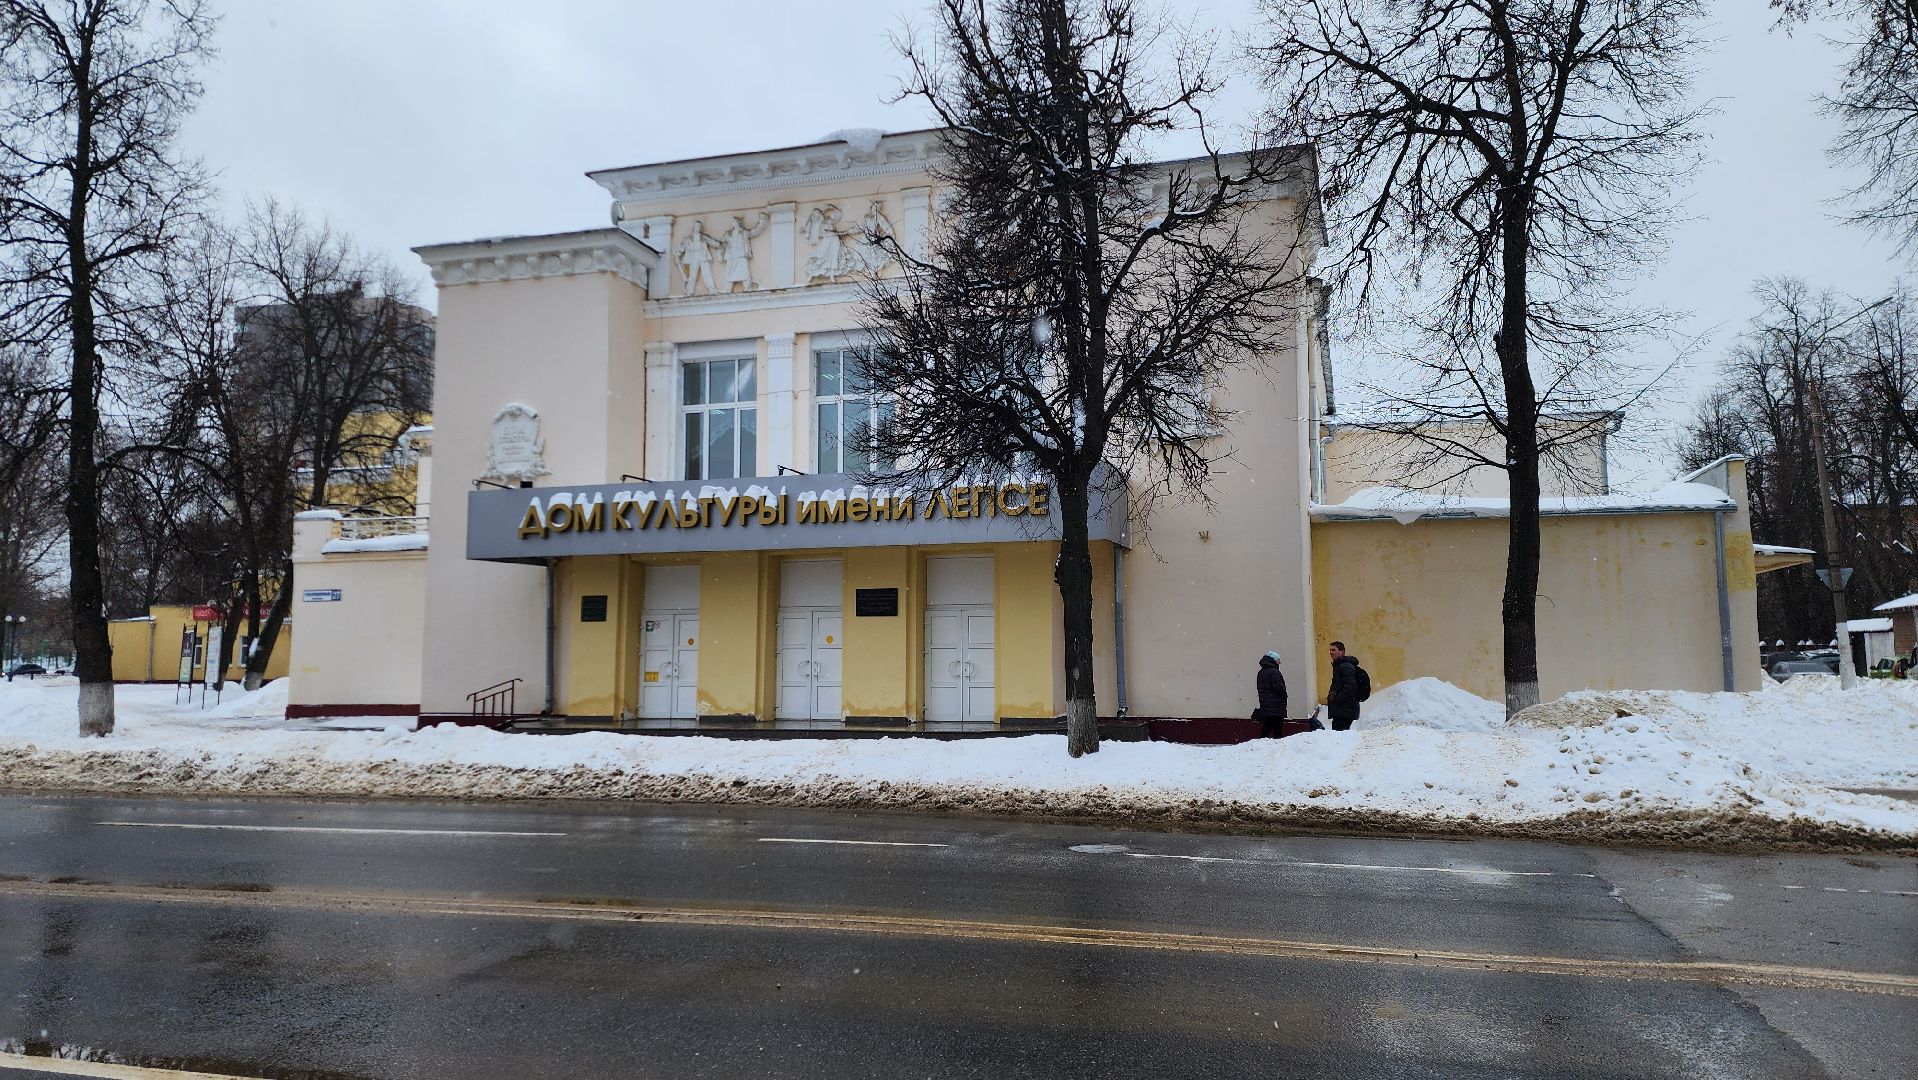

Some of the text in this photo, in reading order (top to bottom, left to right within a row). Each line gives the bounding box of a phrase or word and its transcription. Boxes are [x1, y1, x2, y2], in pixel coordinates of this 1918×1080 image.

[519, 482, 1048, 539] ДОМ КУЛЬТУРЫ имени ЛЕПСЕ
